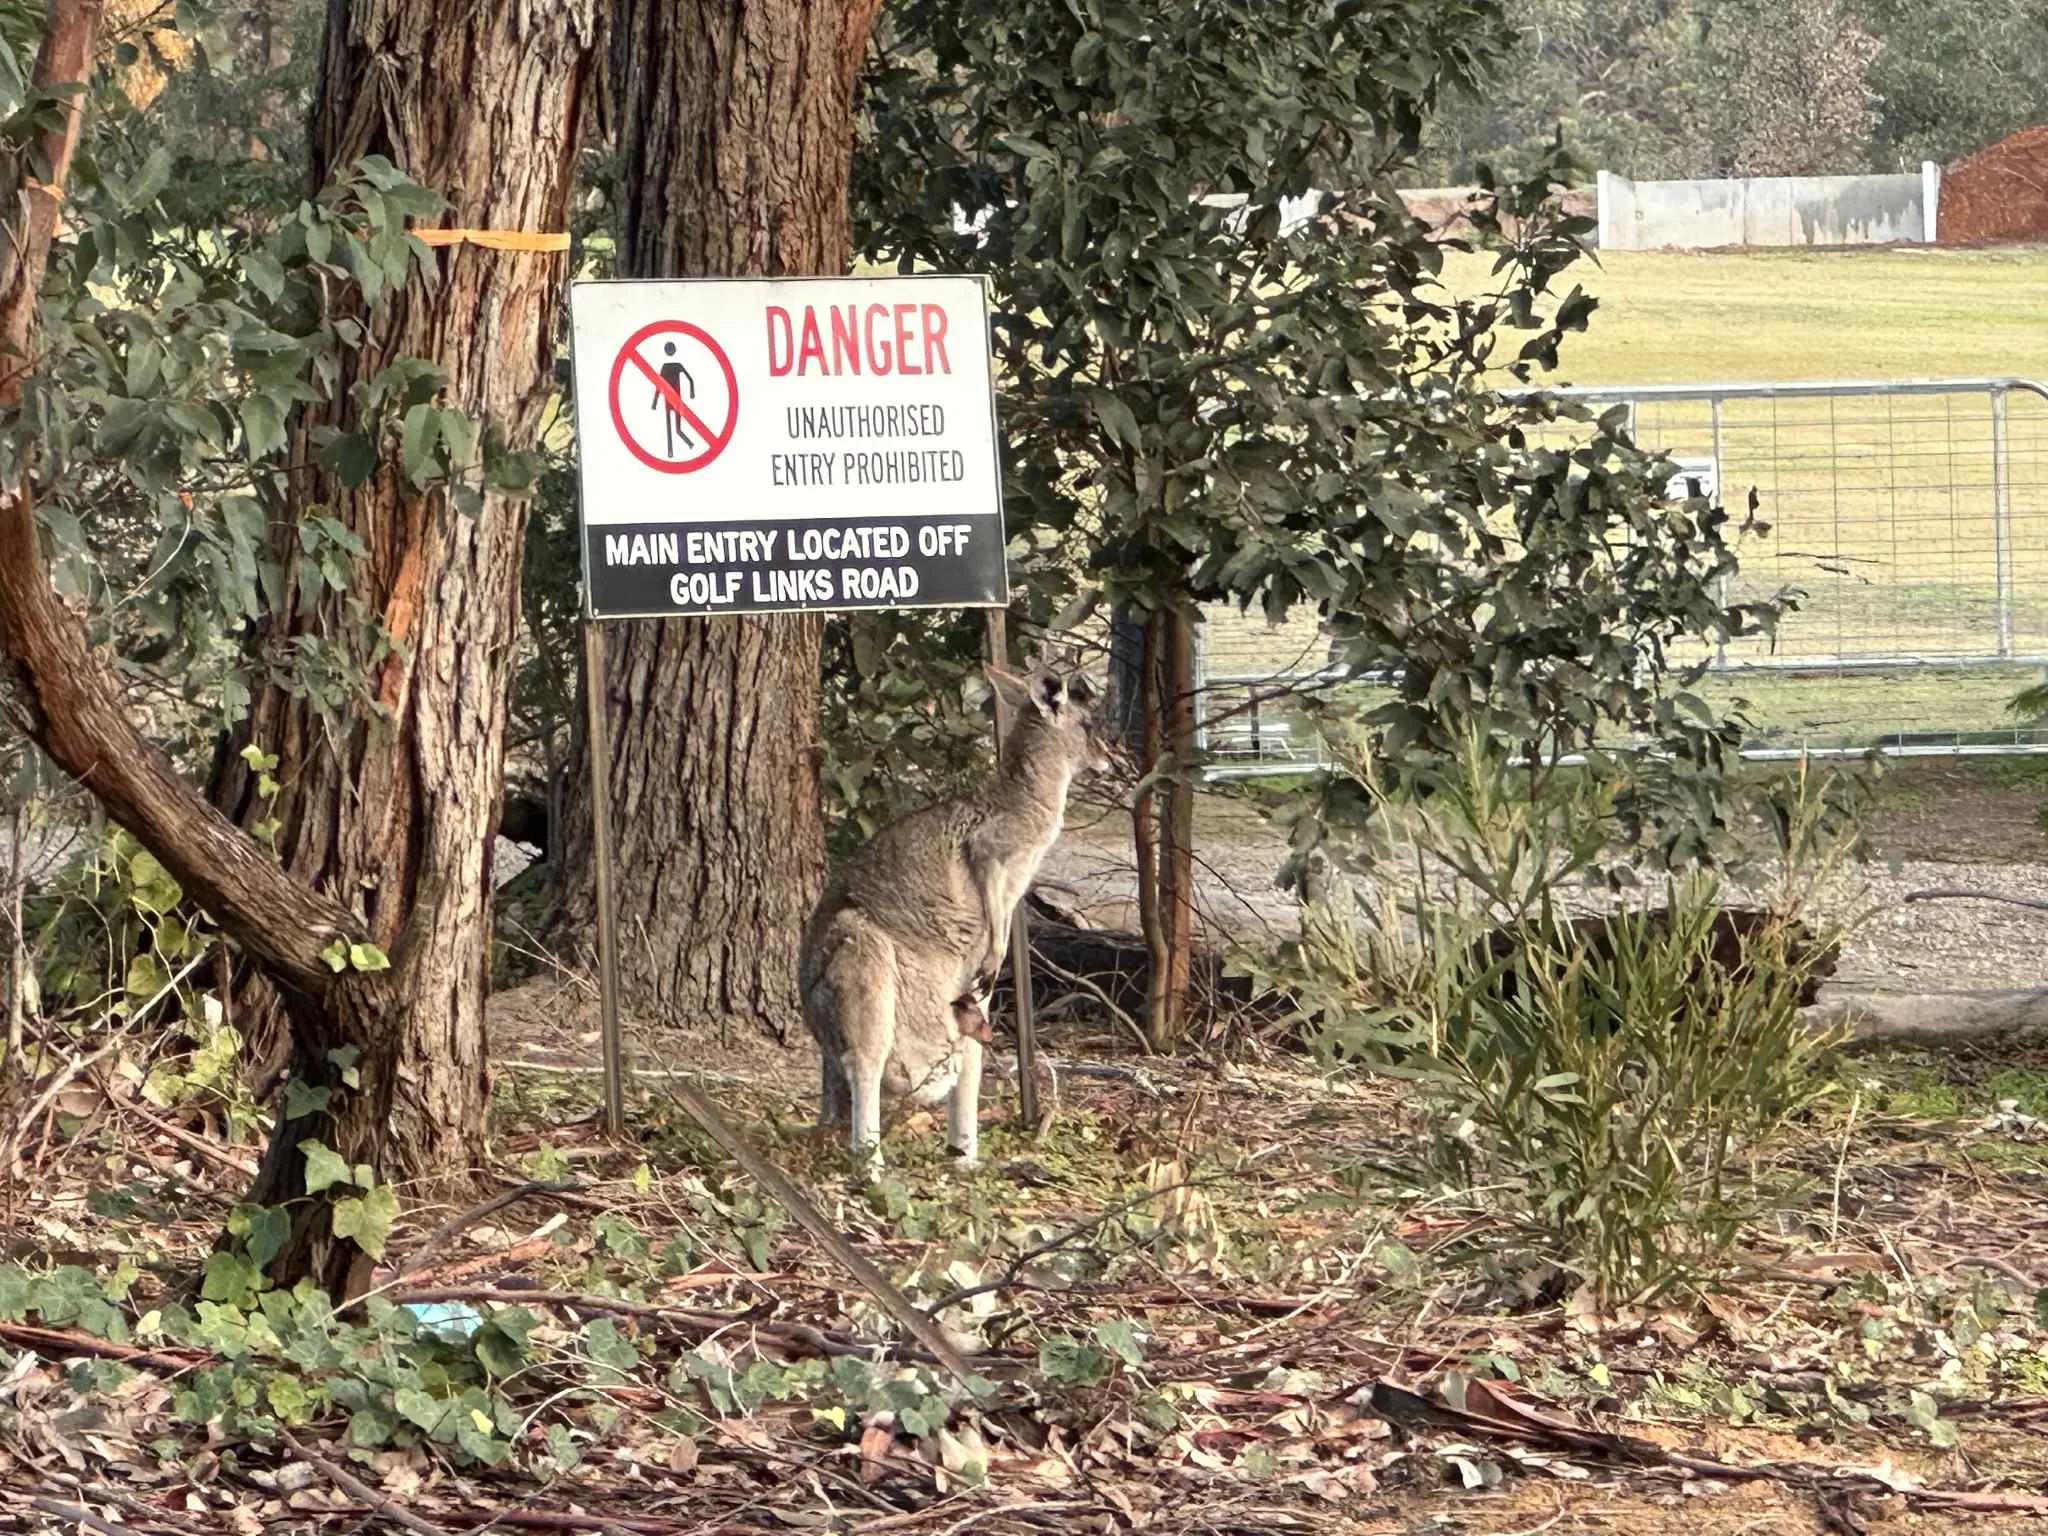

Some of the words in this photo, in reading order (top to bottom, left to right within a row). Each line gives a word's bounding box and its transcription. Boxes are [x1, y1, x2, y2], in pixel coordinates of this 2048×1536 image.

[766, 303, 952, 377] DANGER
[787, 404, 945, 438] UNAUTHORISED
[771, 452, 834, 486] ENTRY
[843, 450, 964, 484] PROHIBITED
[605, 533, 679, 566] MAIN
[687, 530, 778, 564] ENTRY
[787, 527, 910, 561] LOCATED
[919, 525, 972, 556] OFF
[670, 572, 743, 604] GOLF
[752, 570, 834, 602] LINKS
[842, 566, 919, 599] ROAD
